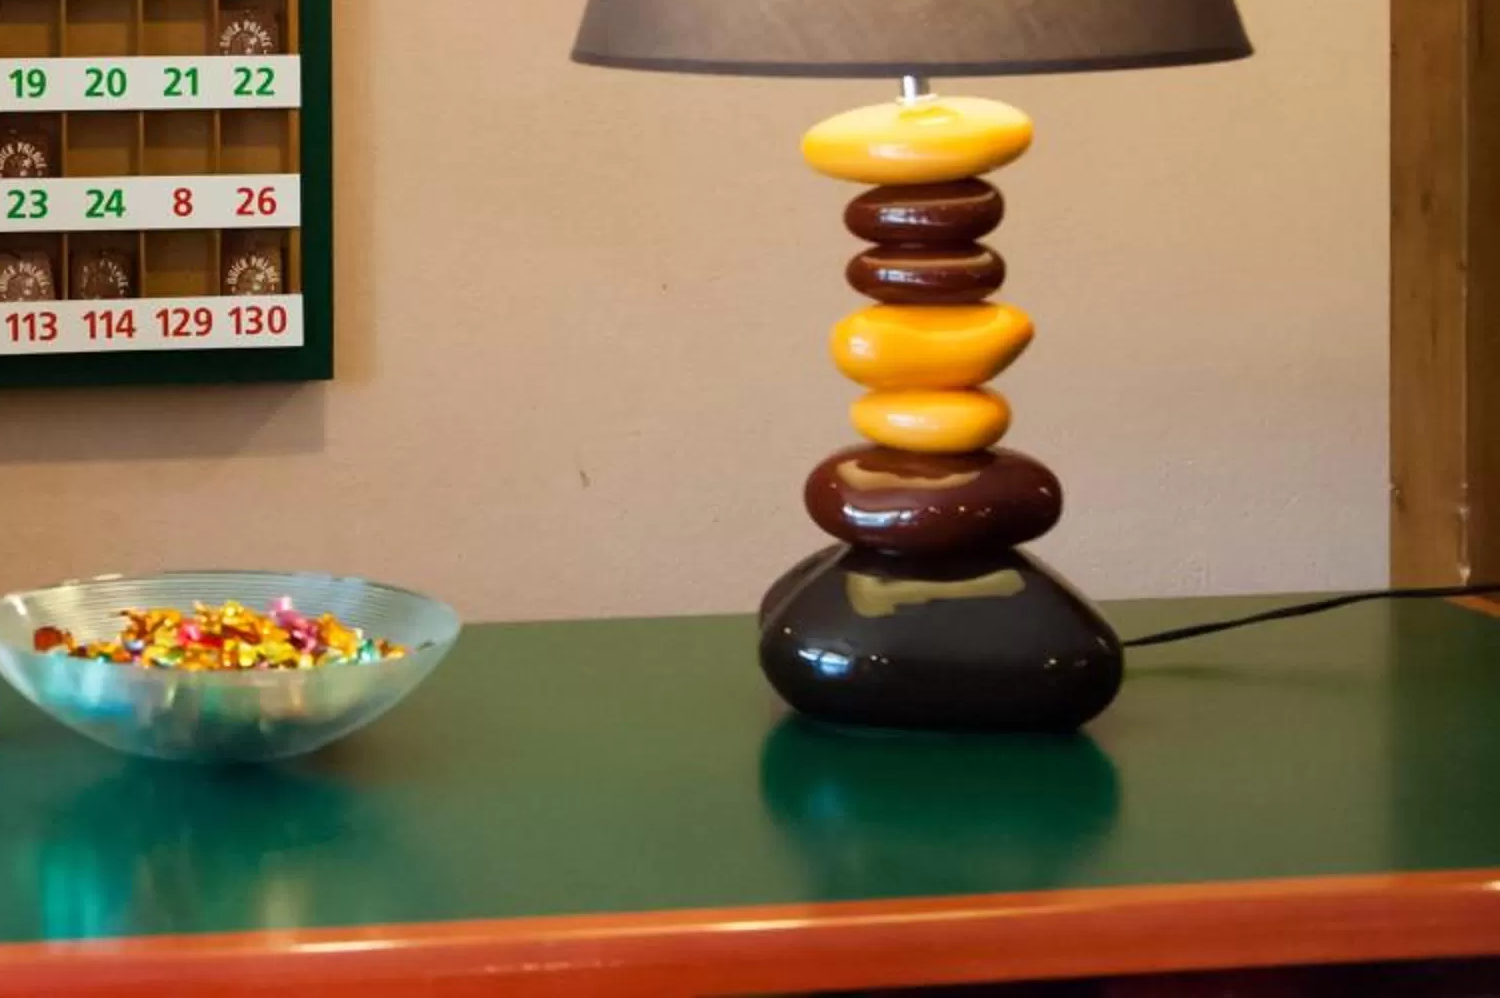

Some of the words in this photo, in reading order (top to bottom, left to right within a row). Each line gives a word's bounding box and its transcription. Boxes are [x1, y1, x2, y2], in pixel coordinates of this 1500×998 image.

[9, 68, 46, 98] 19
[84, 67, 127, 98] 20
[163, 67, 198, 97] 21
[234, 67, 275, 96] 22
[7, 189, 48, 219] 23
[85, 189, 126, 218] 24
[173, 187, 193, 217] 8
[236, 186, 276, 216] 26
[5, 311, 58, 342] 113
[82, 309, 137, 340] 114
[155, 307, 213, 338] 129
[228, 306, 287, 335] 130
